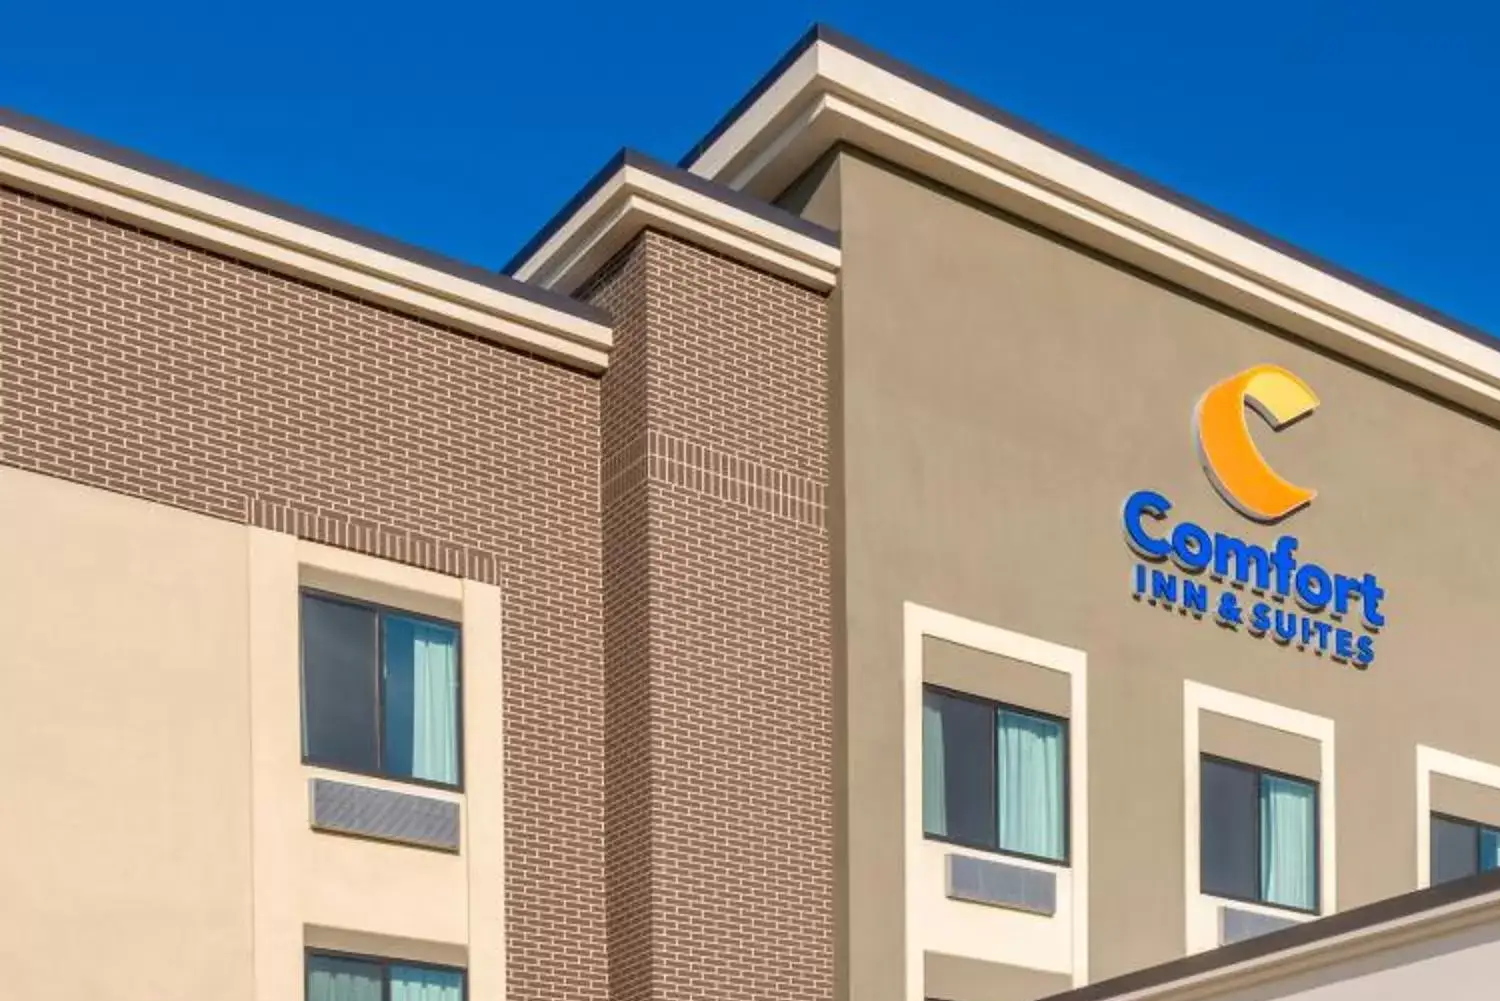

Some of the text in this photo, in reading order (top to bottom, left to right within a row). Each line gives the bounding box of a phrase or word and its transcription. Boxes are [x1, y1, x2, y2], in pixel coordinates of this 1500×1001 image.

[1122, 489, 1386, 629] Comfort
[1134, 564, 1375, 666] INN & SUITES
